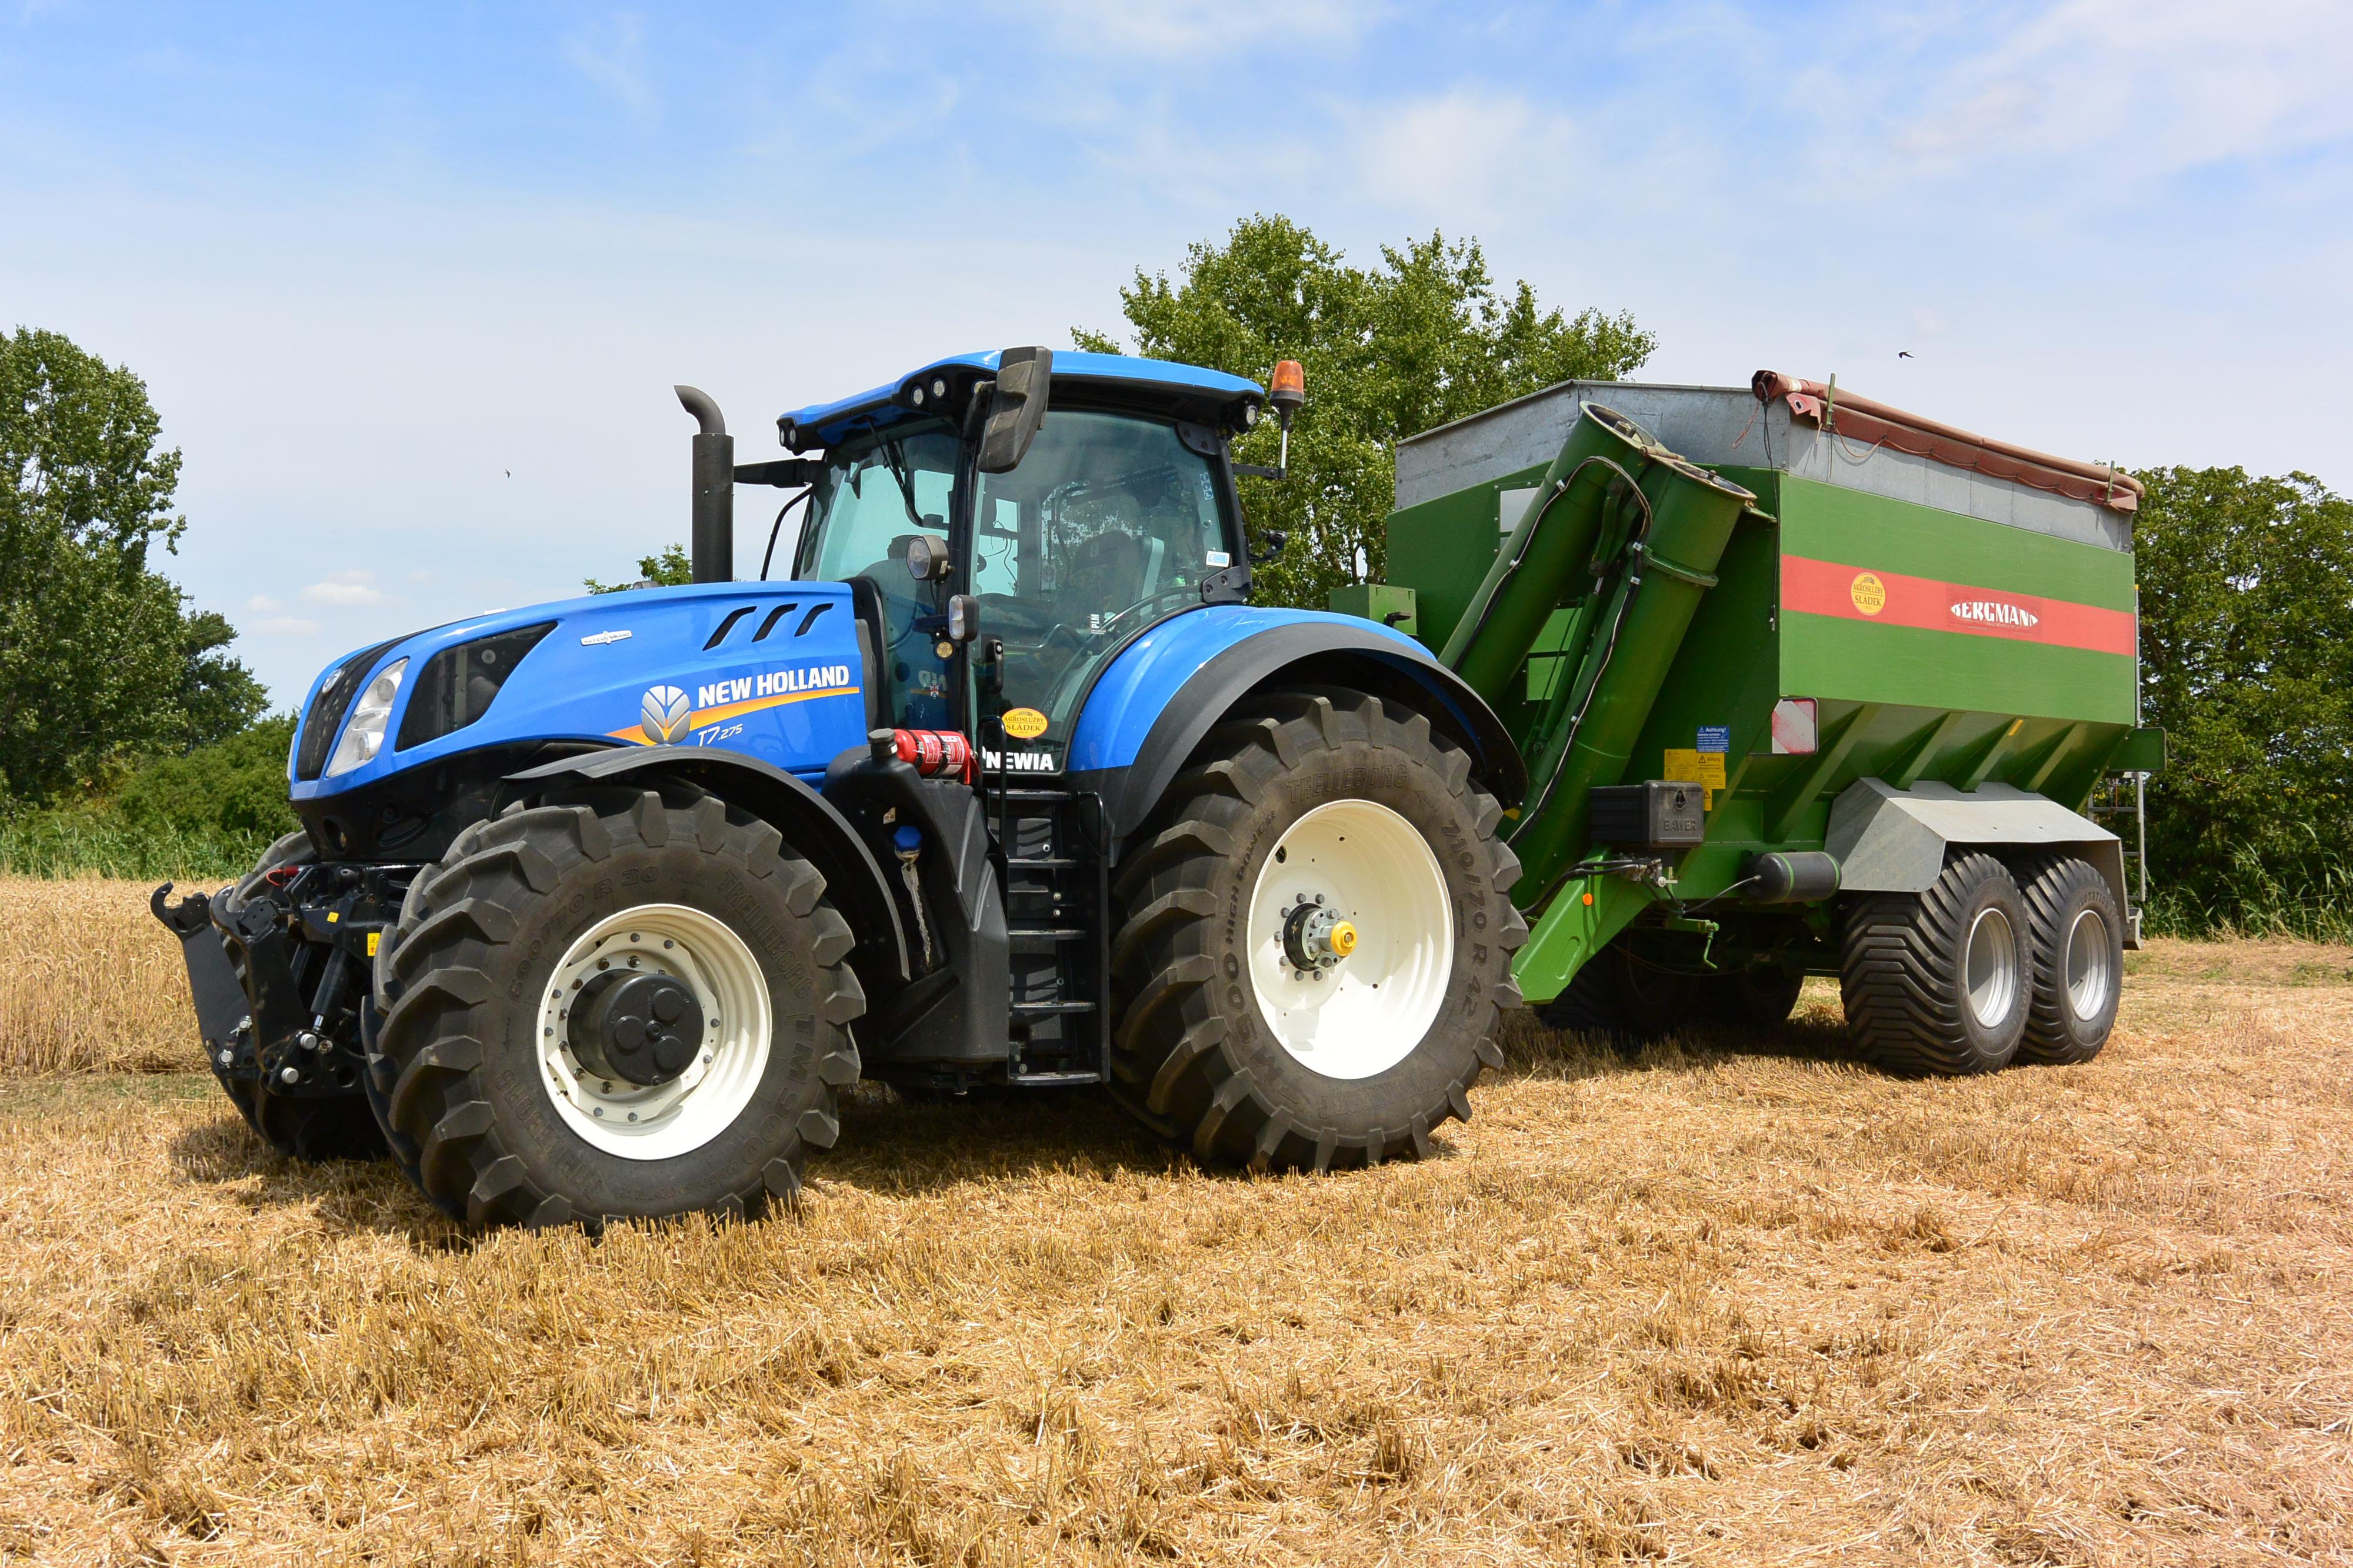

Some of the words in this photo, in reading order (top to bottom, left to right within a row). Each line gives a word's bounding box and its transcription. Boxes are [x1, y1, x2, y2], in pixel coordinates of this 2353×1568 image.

[1855, 593, 1881, 606] SLÁDEK
[698, 676, 752, 708] NEW
[757, 665, 849, 696] HOLLAND
[698, 723, 744, 748] T7.275
[1006, 723, 1042, 732] SLÁDEK
[1287, 764, 1408, 804] TRELLEBORG
[1664, 819, 1696, 832] BAWER
[1225, 885, 1239, 945] HIGH
[1236, 809, 1276, 883] POWER
[1442, 818, 1488, 933] 710/70
[717, 869, 815, 999] TRELLEBORG
